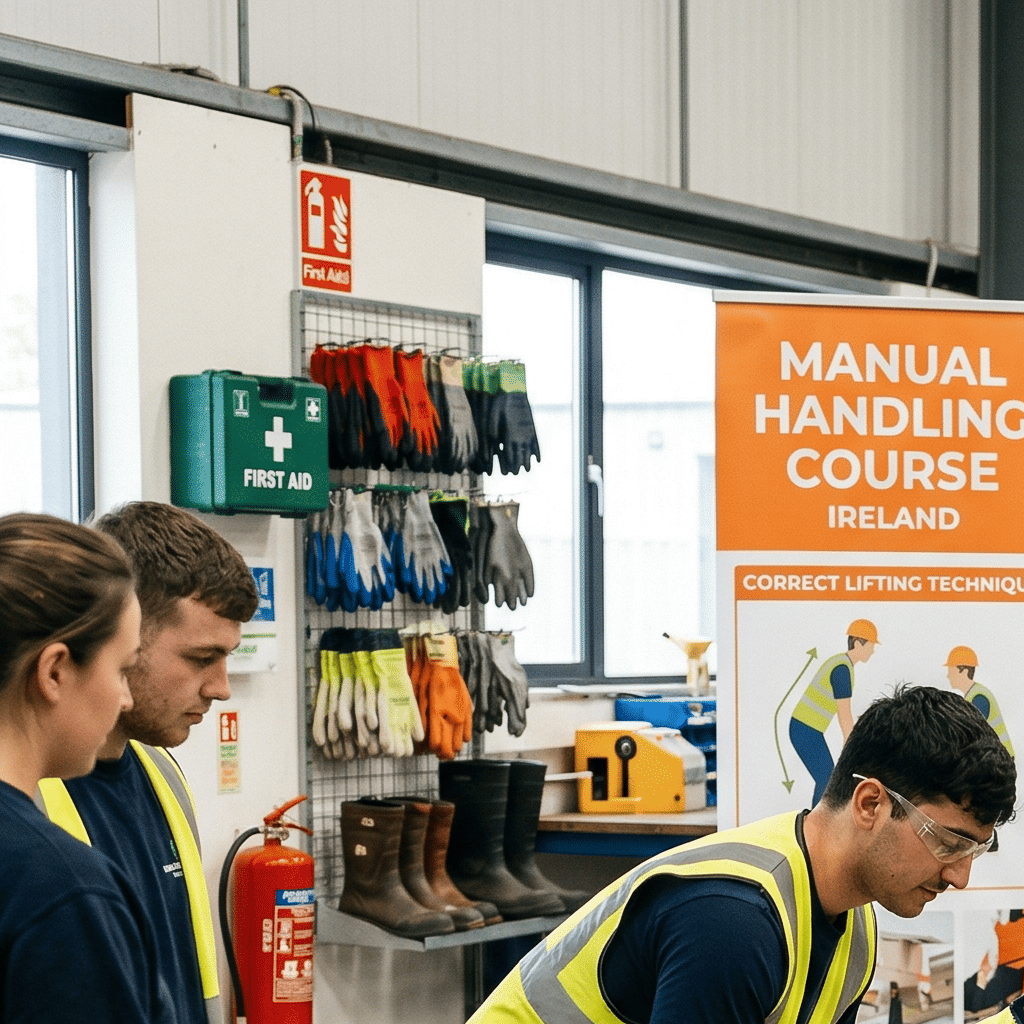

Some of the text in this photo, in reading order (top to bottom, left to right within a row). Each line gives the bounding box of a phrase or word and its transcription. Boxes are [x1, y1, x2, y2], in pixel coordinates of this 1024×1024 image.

[780, 340, 1007, 387] MANUAL
[243, 468, 312, 490] FIRST AID
[786, 447, 1000, 491] COURSE
[828, 504, 961, 531] IRELAND
[742, 573, 839, 591] CORRECT
[845, 575, 922, 592] LIFTING
